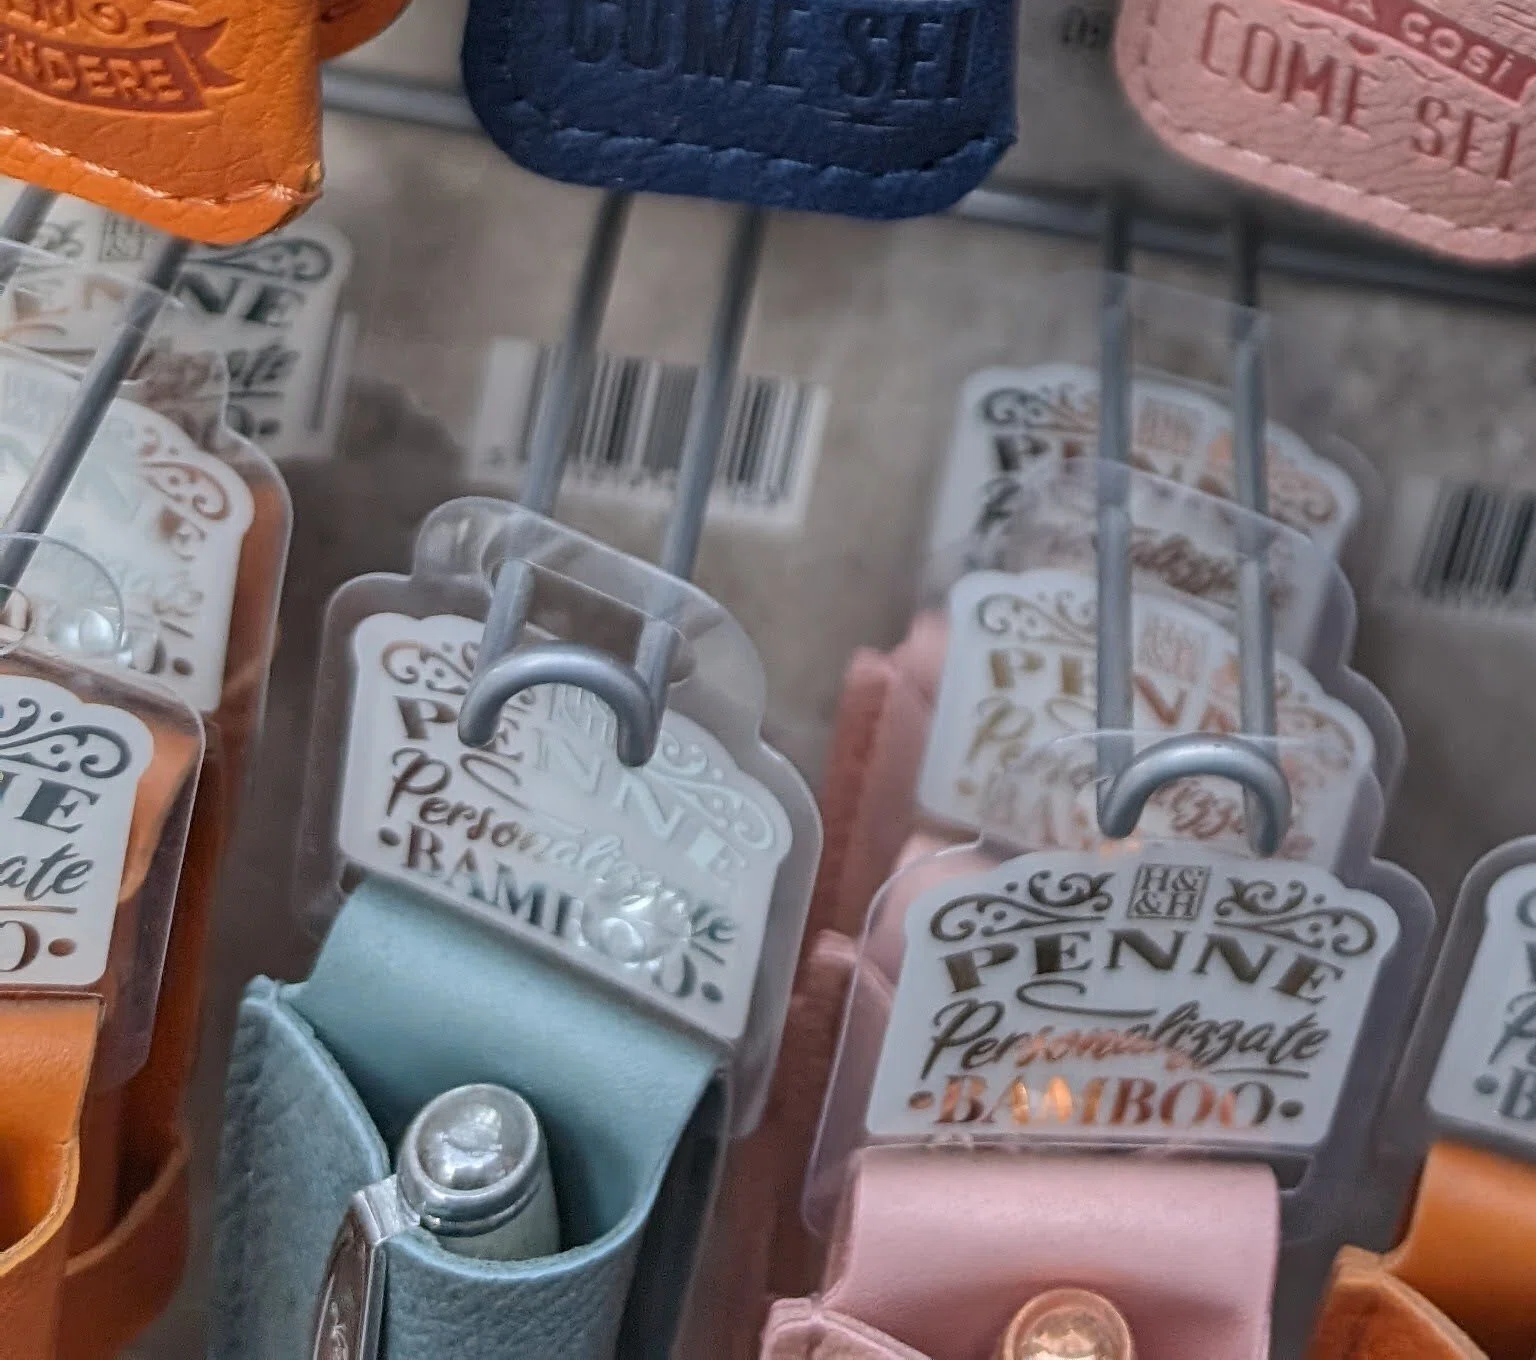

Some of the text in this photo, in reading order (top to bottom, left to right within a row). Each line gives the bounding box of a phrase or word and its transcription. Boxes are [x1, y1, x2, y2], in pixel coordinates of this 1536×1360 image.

[838, 6, 978, 104] SEI
[1200, 0, 1370, 136] COME
[1409, 94, 1523, 183] SEI
[936, 926, 1346, 1007] PENNE
[920, 979, 1331, 1080] Personalizzate
[933, 1073, 1276, 1128] BAMBOO
